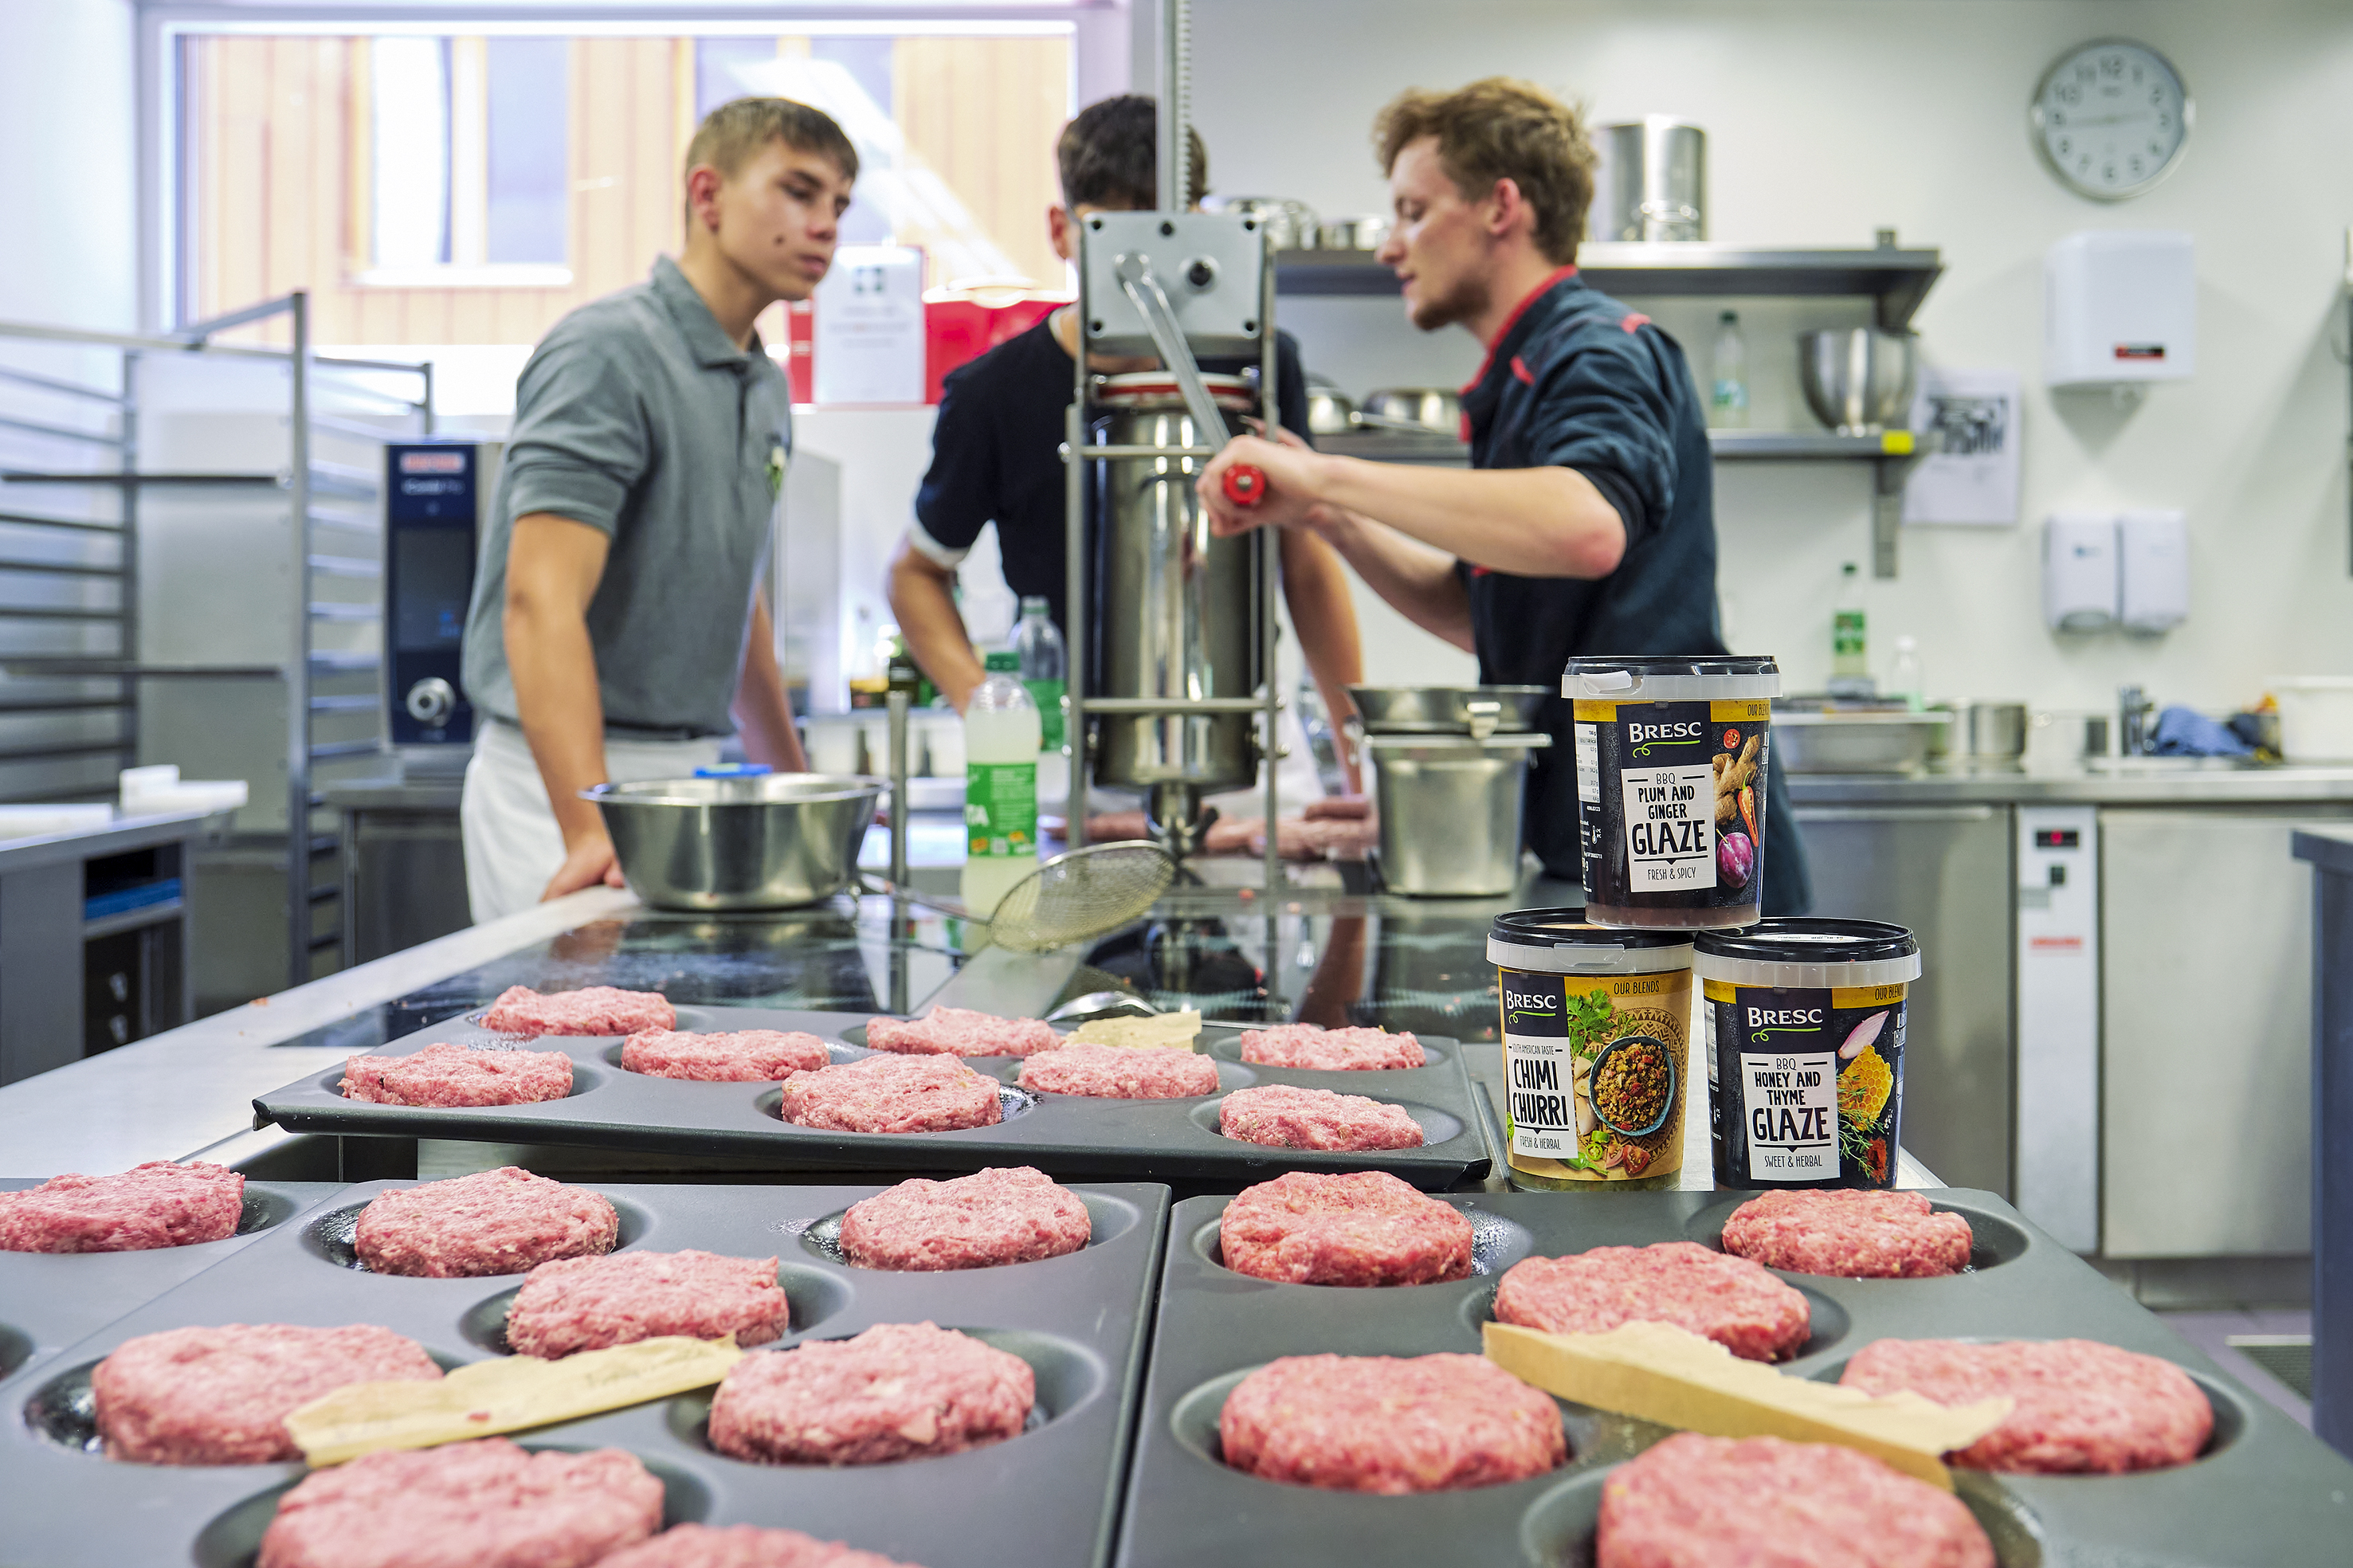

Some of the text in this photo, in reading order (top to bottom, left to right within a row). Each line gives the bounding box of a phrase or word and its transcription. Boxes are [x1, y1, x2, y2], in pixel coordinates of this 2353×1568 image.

[1629, 722, 1702, 743] BRESC
[1656, 772, 1677, 785] BBQ
[1637, 785, 1695, 802] PLUM AND
[1648, 803, 1688, 820] GINGER
[1632, 819, 1708, 855] GLAZE
[1648, 867, 1696, 880] FRESH & SPICY
[1614, 980, 1660, 994] OUR BLENDS
[1875, 987, 1888, 1000] OUR
[1506, 990, 1558, 1009] BRESC
[1747, 1007, 1823, 1027] BRESC
[1522, 1045, 1541, 1055] AMERICAN
[1541, 1045, 1555, 1056] TASTE
[1776, 1058, 1797, 1070] BBQ
[1514, 1058, 1559, 1091] CHIMI
[1755, 1071, 1822, 1088] HONEY AND
[1767, 1089, 1806, 1105] THYME
[1513, 1092, 1568, 1126] CHURRI
[1752, 1107, 1831, 1142] GLAZE
[1520, 1135, 1561, 1151] FRESH & HERBAL
[1764, 1154, 1823, 1168] SWEET & HERBAL
